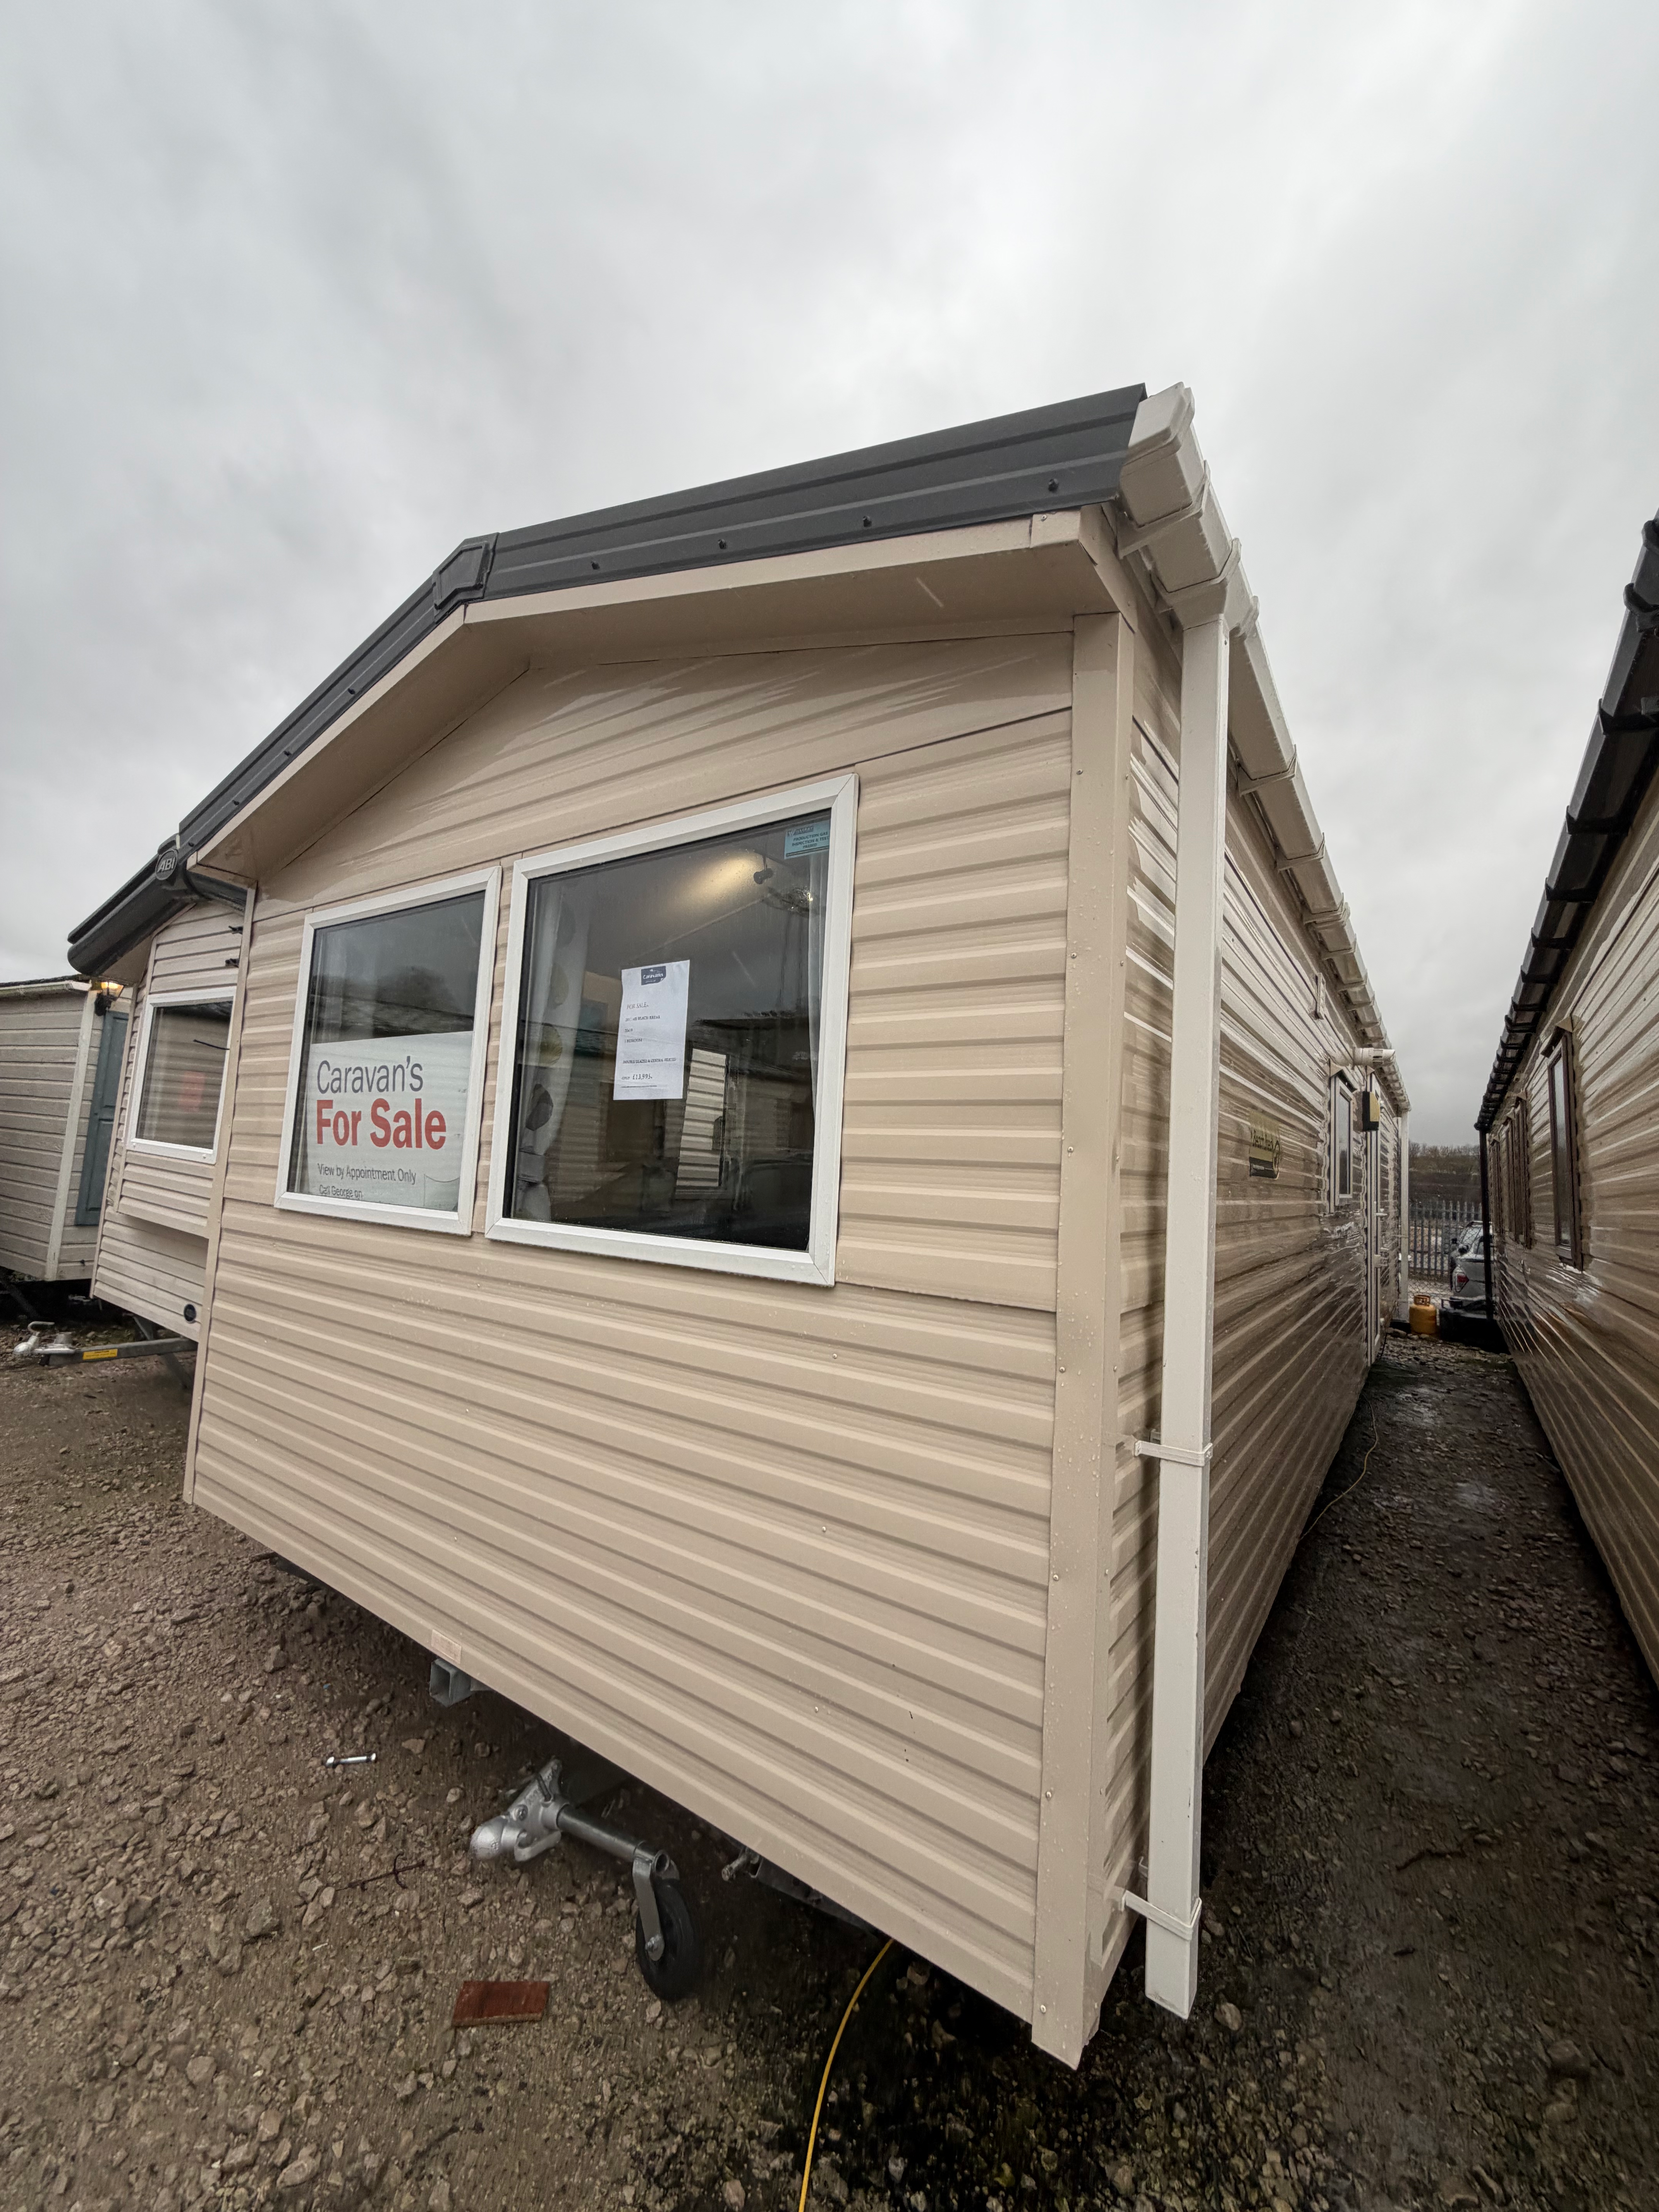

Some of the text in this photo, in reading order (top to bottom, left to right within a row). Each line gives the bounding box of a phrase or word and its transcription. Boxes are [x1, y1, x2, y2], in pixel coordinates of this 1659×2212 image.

[157, 857, 175, 873] ABI
[317, 1056, 423, 1094] Caravan's
[316, 1098, 446, 1150] For Sale
[318, 1163, 416, 1185] View by Appointment Only
[319, 1185, 363, 1198] Call George on
